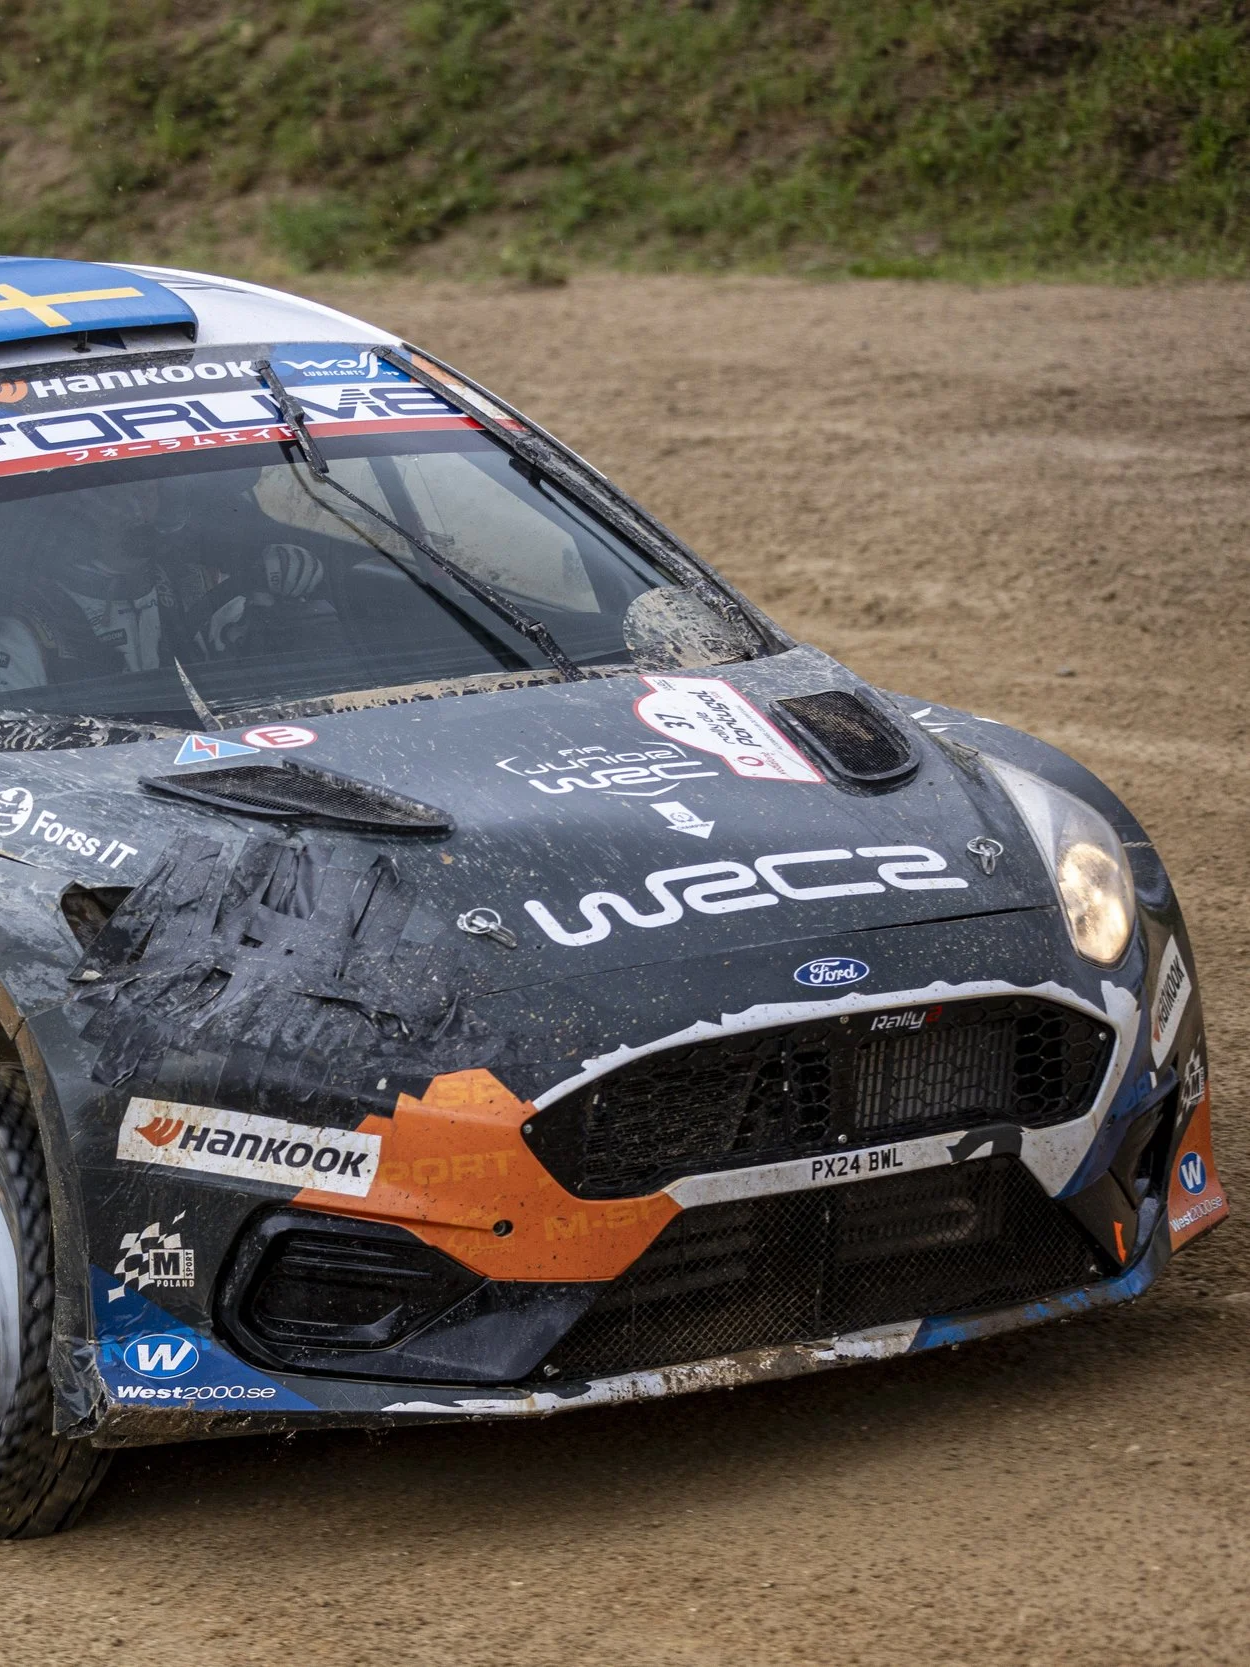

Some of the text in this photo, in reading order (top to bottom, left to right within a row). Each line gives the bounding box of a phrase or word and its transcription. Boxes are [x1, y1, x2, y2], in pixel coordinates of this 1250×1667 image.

[303, 369, 365, 377] LUBRICANTS
[654, 712, 696, 730] 37
[255, 728, 305, 746] E
[524, 750, 678, 775] JUNIOR
[557, 745, 607, 757] FIA
[528, 761, 719, 794] WRC
[30, 810, 139, 869] Forss IT
[524, 845, 969, 946] WRC2
[809, 961, 858, 984] Ford
[870, 1004, 943, 1031] Rally2
[812, 1147, 903, 1181] PX24 BWL
[1181, 1154, 1202, 1190] W
[1169, 1196, 1224, 1233] West2000.se
[153, 1252, 181, 1276] M
[156, 1279, 195, 1288] POLAND
[137, 1340, 194, 1371] W
[117, 1385, 276, 1400] West2000.se
